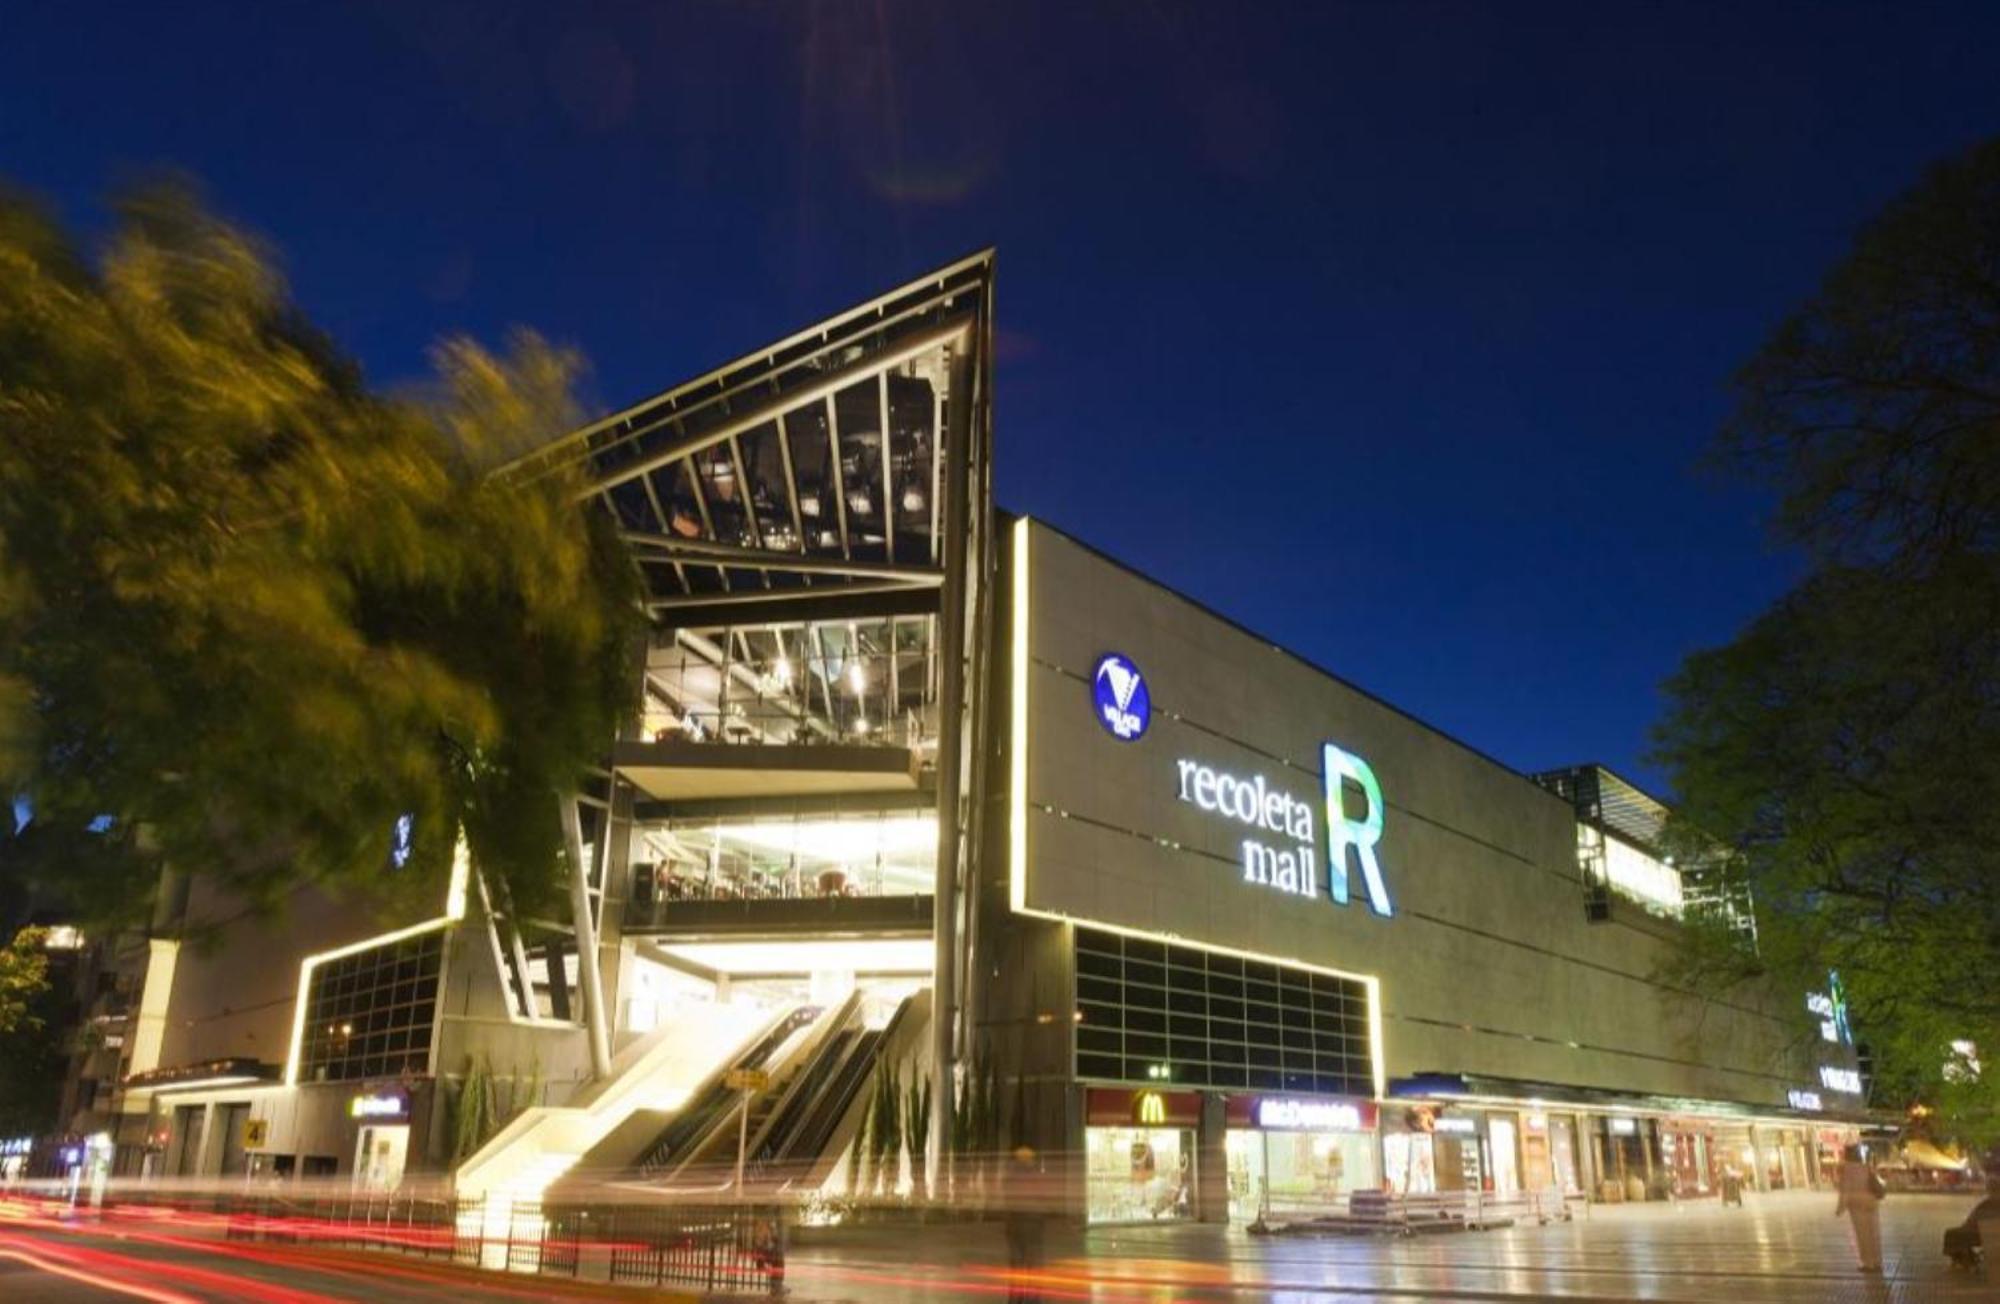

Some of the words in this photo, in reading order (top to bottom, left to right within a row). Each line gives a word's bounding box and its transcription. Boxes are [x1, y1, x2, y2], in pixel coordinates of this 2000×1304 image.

[1176, 757, 1315, 843] recoleta
[1322, 741, 1393, 917] R
[1242, 839, 1317, 898] mall
